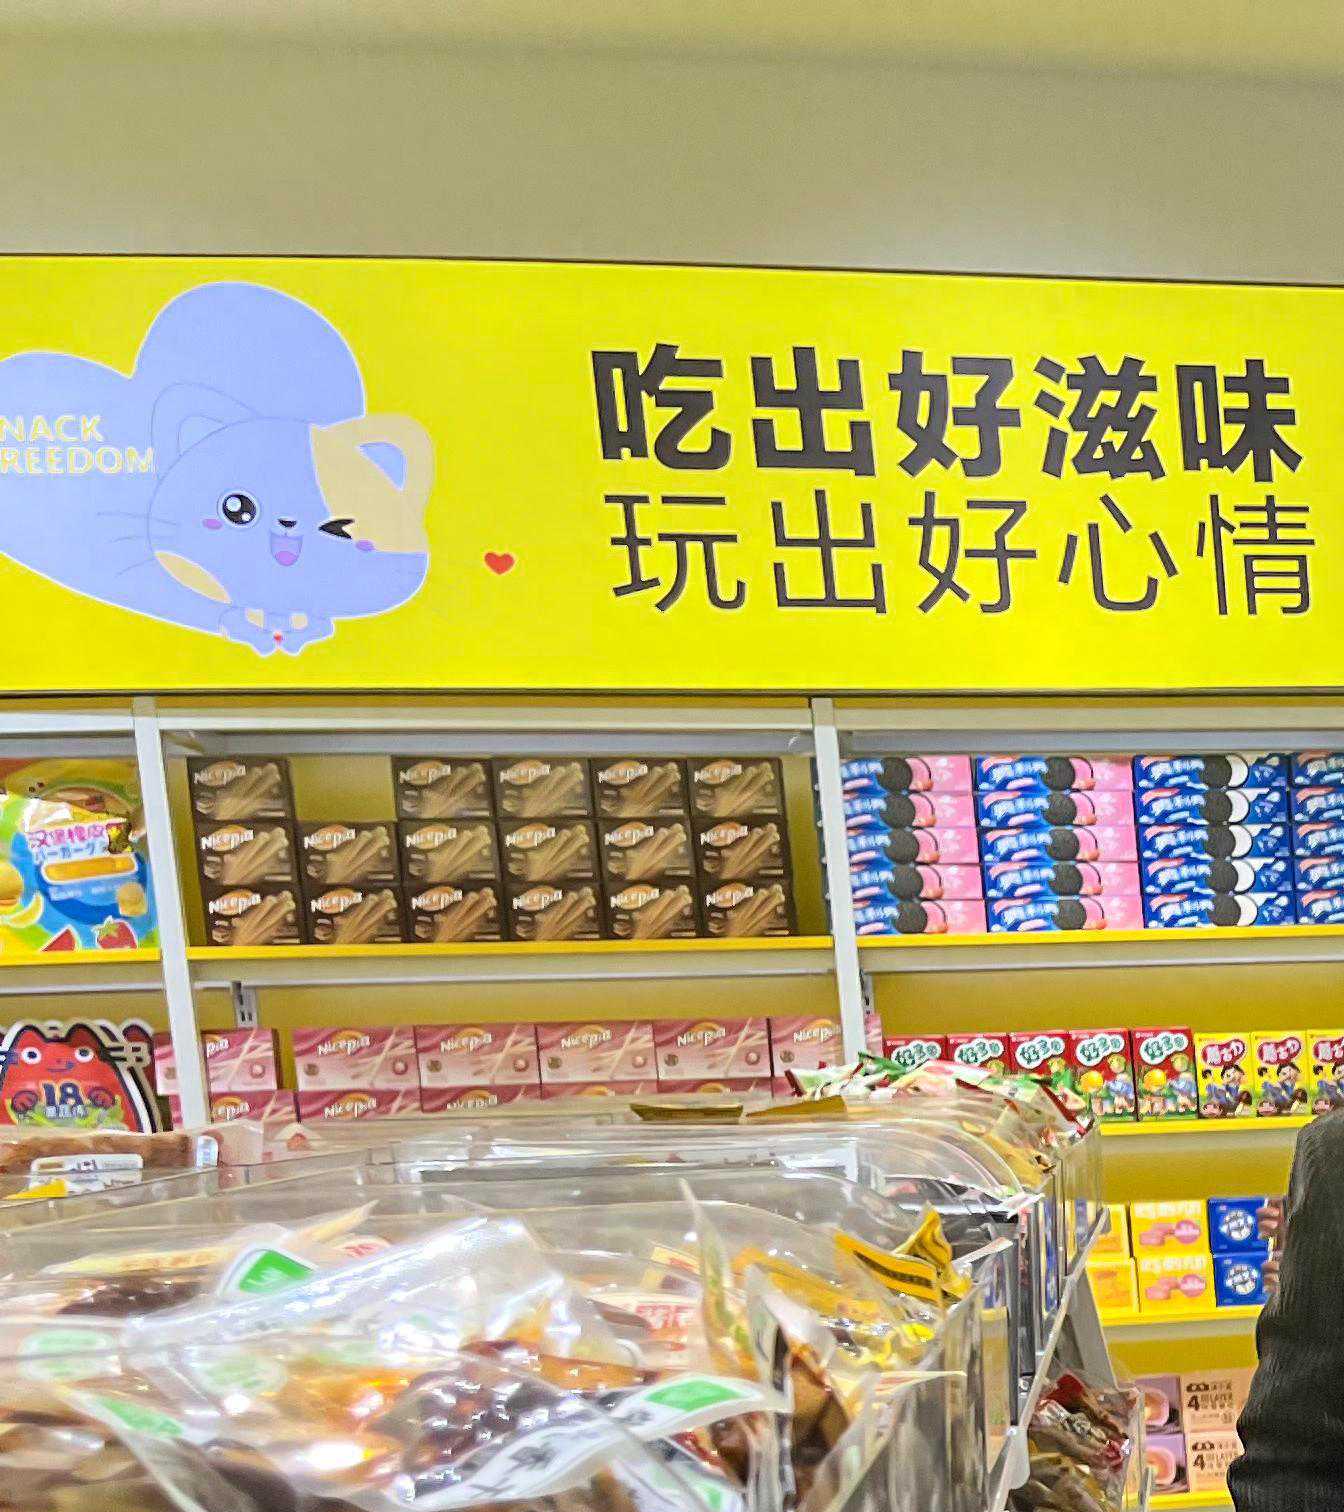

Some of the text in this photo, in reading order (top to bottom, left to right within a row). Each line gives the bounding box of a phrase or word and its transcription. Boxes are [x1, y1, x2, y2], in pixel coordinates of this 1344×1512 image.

[591, 342, 1302, 483] 吃出好滋味
[603, 487, 1316, 616] 玩出好心情
